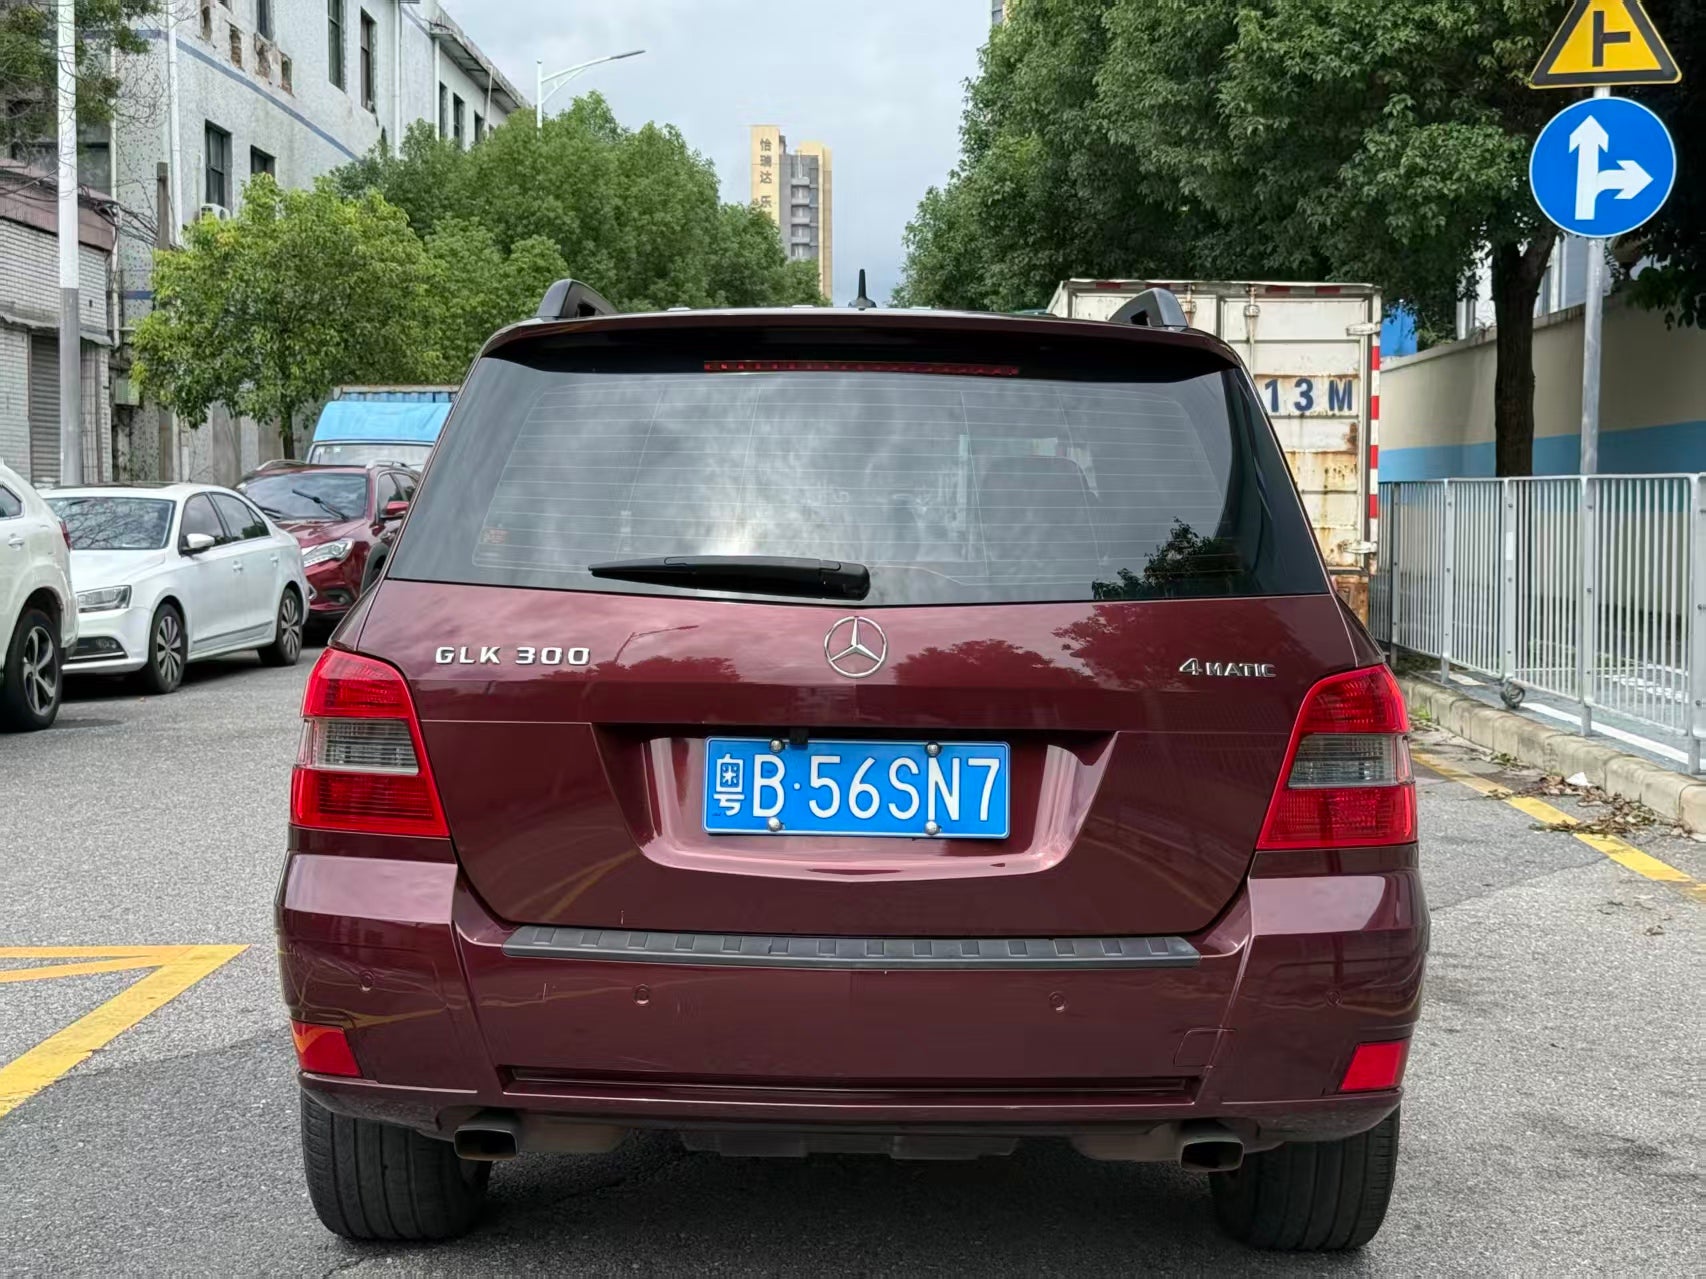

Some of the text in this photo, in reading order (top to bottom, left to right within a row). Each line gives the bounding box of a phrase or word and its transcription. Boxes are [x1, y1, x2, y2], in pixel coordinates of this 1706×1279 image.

[435, 646, 591, 665] GLK 300
[1178, 657, 1277, 678] 4MATIC
